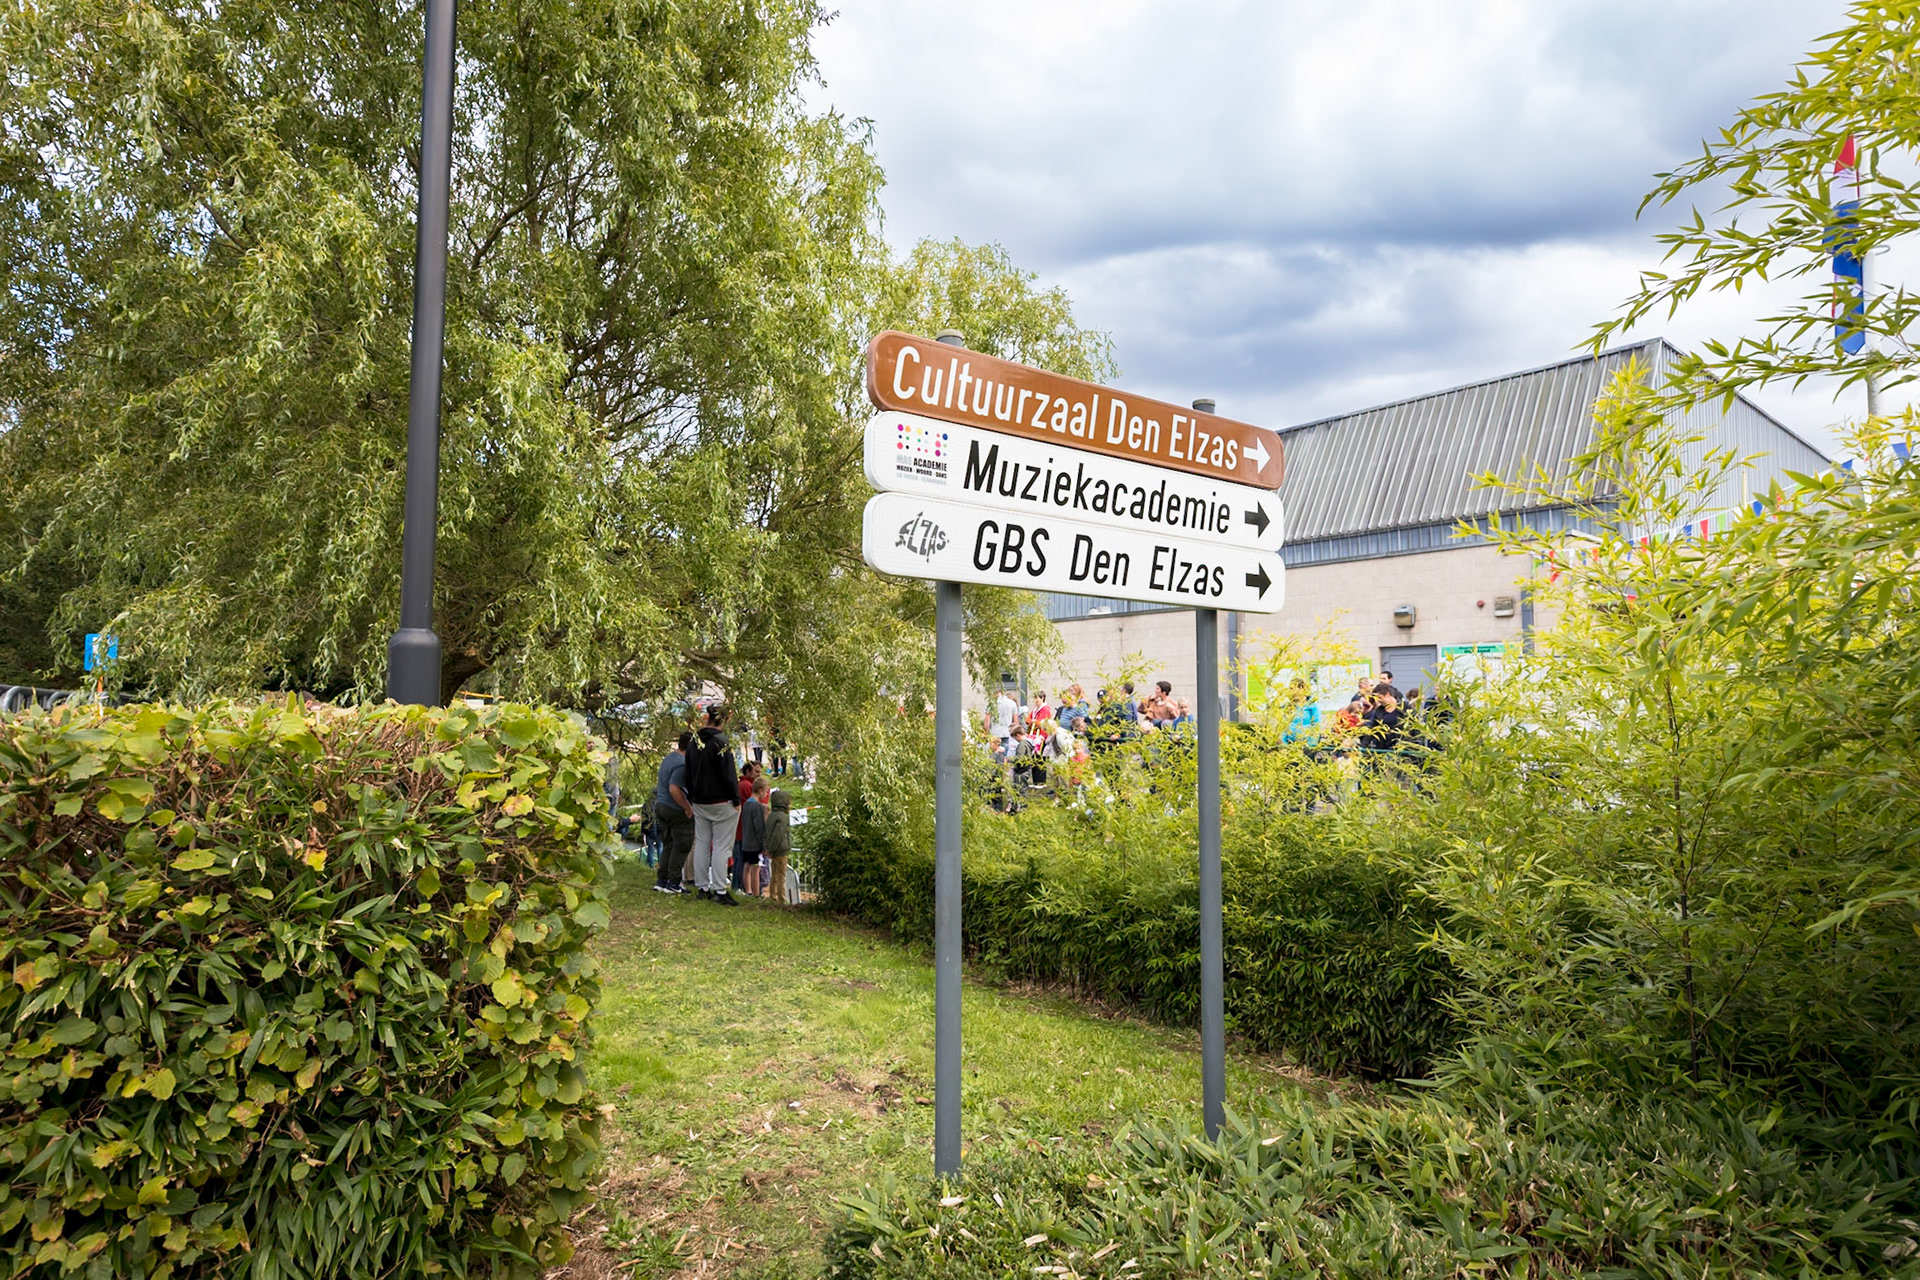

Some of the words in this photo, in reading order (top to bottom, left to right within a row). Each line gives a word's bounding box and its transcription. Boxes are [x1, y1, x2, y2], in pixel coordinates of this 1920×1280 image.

[893, 346, 1099, 440] Cultuurzaal
[1107, 398, 1160, 453] Den
[1169, 414, 1238, 470] Elzas
[913, 457, 947, 471] ACADEMIE
[963, 440, 1231, 534] Muziekacademie
[973, 520, 1050, 577] GBS
[1070, 534, 1130, 586] Den
[1149, 546, 1224, 598] Elzas
